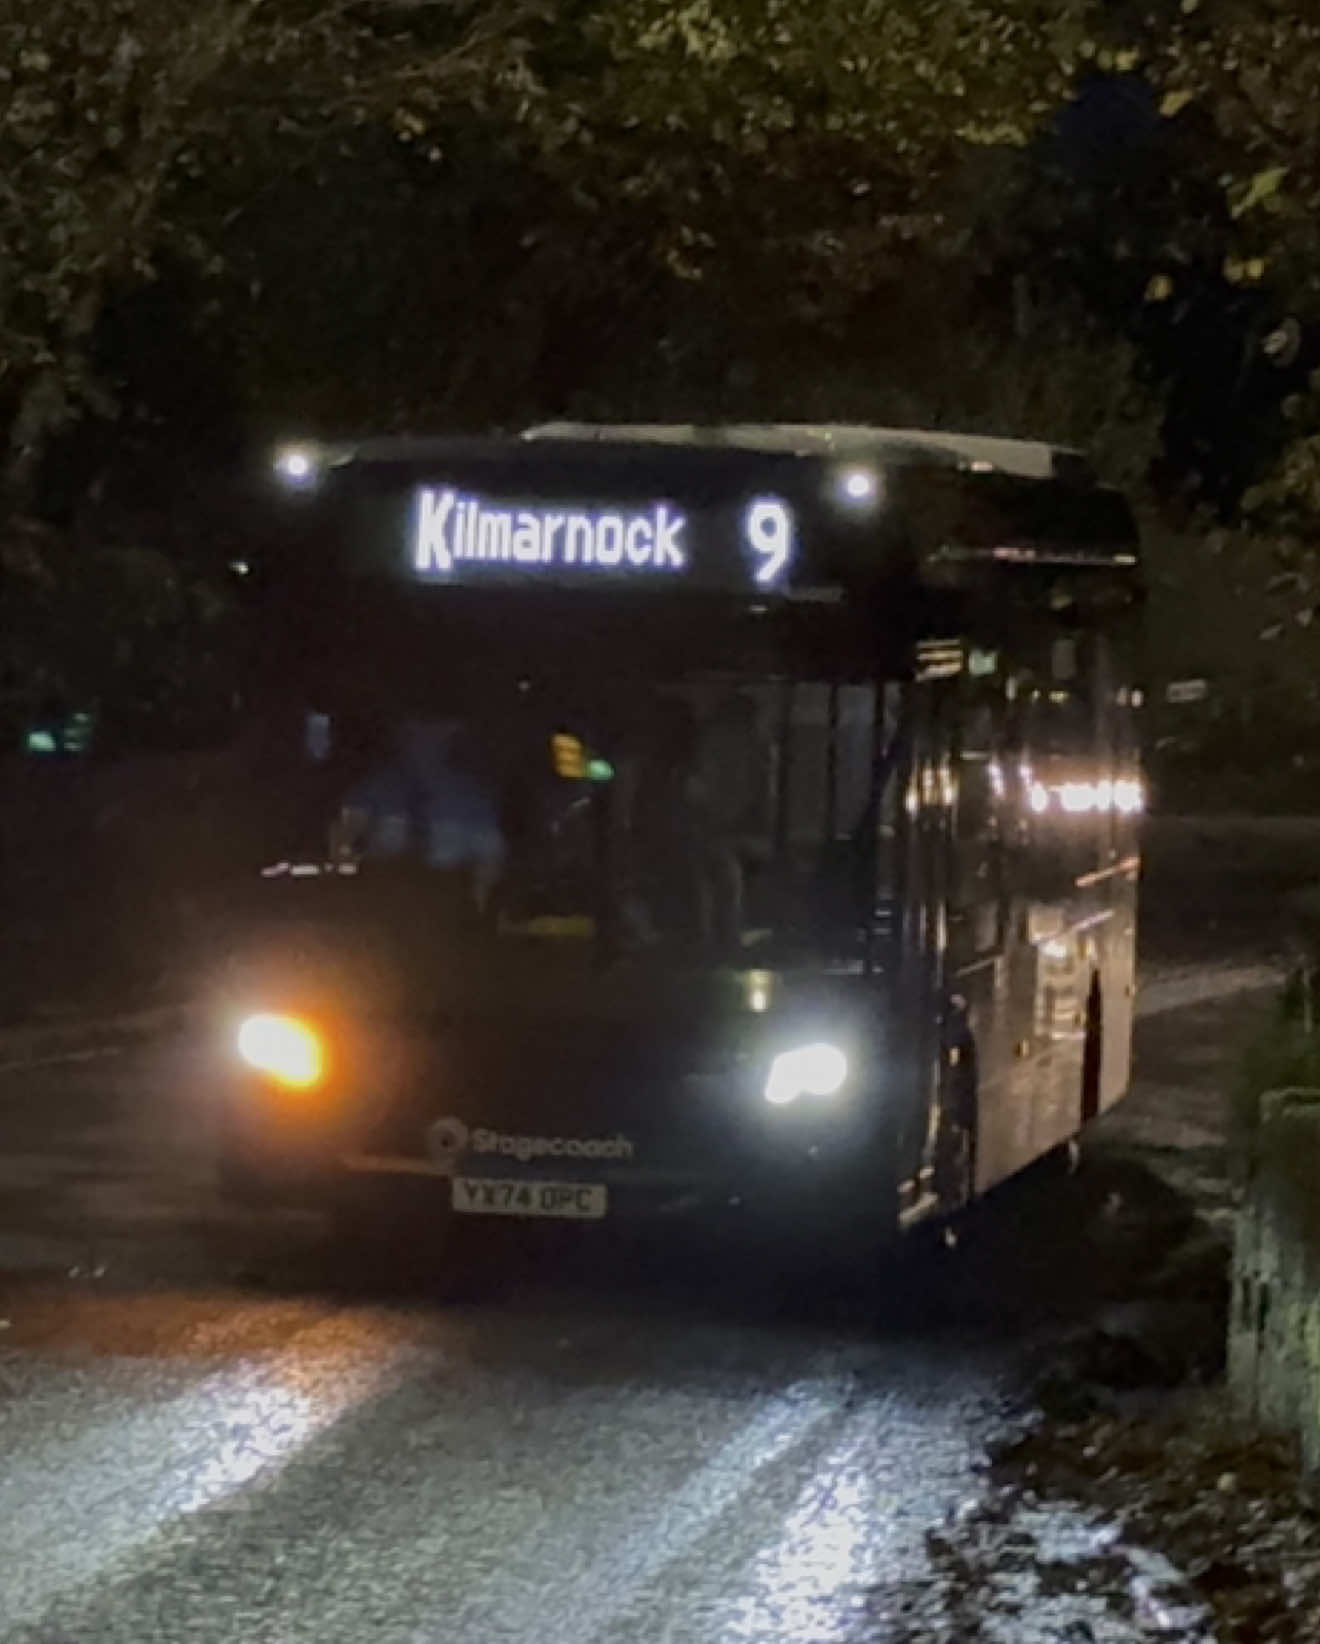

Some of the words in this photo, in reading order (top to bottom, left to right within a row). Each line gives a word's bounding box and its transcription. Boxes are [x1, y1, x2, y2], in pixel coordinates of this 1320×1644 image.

[415, 489, 686, 571] Kilmarnock
[746, 501, 792, 582] 9
[472, 1128, 634, 1160] Stagecoach
